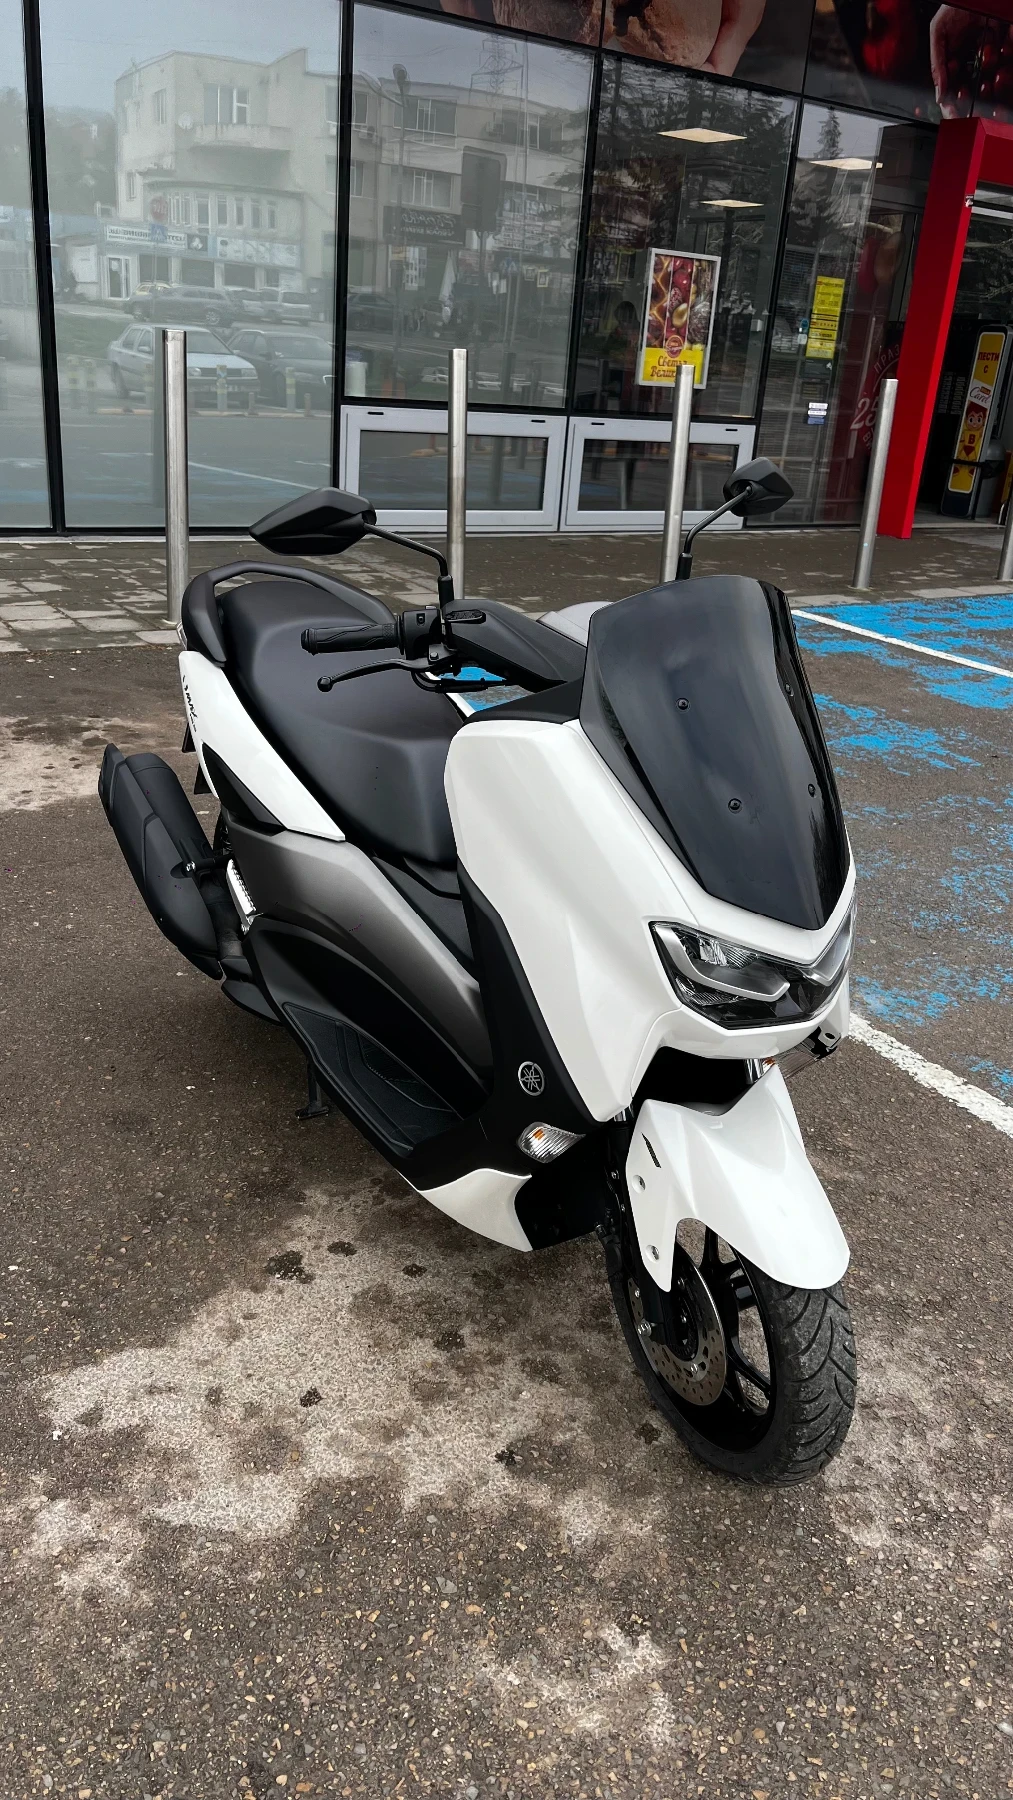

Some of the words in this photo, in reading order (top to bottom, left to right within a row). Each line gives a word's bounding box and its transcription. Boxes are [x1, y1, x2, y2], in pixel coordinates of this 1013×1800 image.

[873, 344, 900, 374] ПРАЗ
[650, 365, 676, 378] Велик
[969, 386, 992, 404] Card
